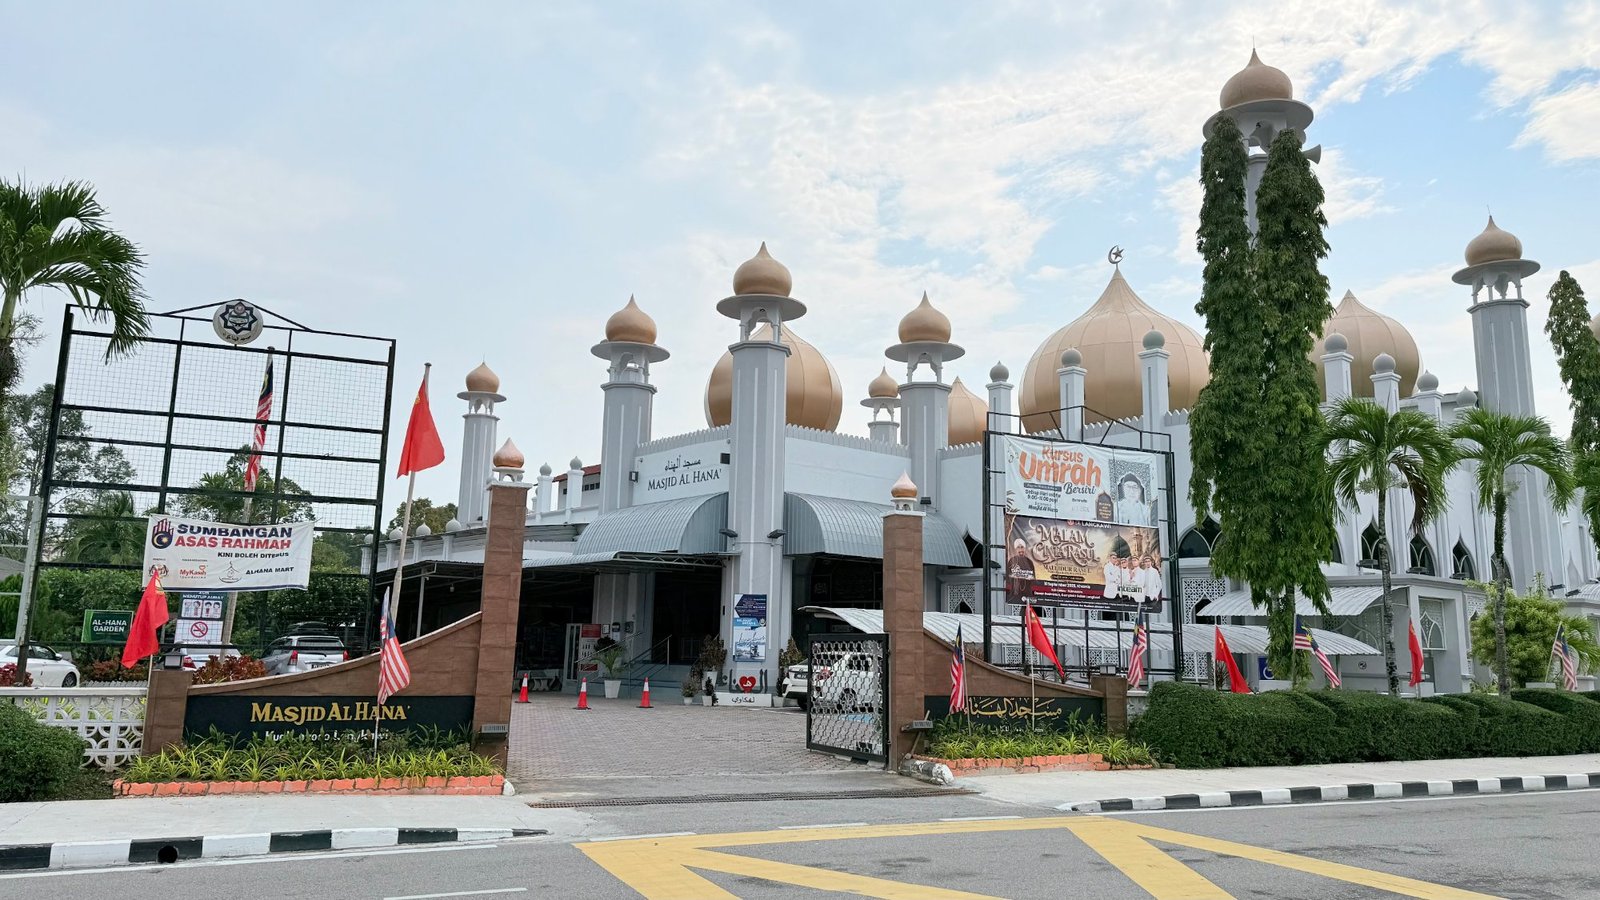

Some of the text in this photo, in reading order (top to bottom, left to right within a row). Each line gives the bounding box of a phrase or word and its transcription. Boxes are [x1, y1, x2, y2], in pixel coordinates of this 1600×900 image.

[1042, 446, 1083, 462] Kursus
[1019, 451, 1101, 487] Umrah
[647, 476, 677, 491] MASJID
[679, 473, 690, 485] AL
[177, 524, 292, 538] SUMBANGAN
[1036, 523, 1095, 548] MALAM
[174, 535, 292, 550] ASAS RAHMAH
[250, 702, 325, 726] MASJID
[327, 702, 352, 721] AL
